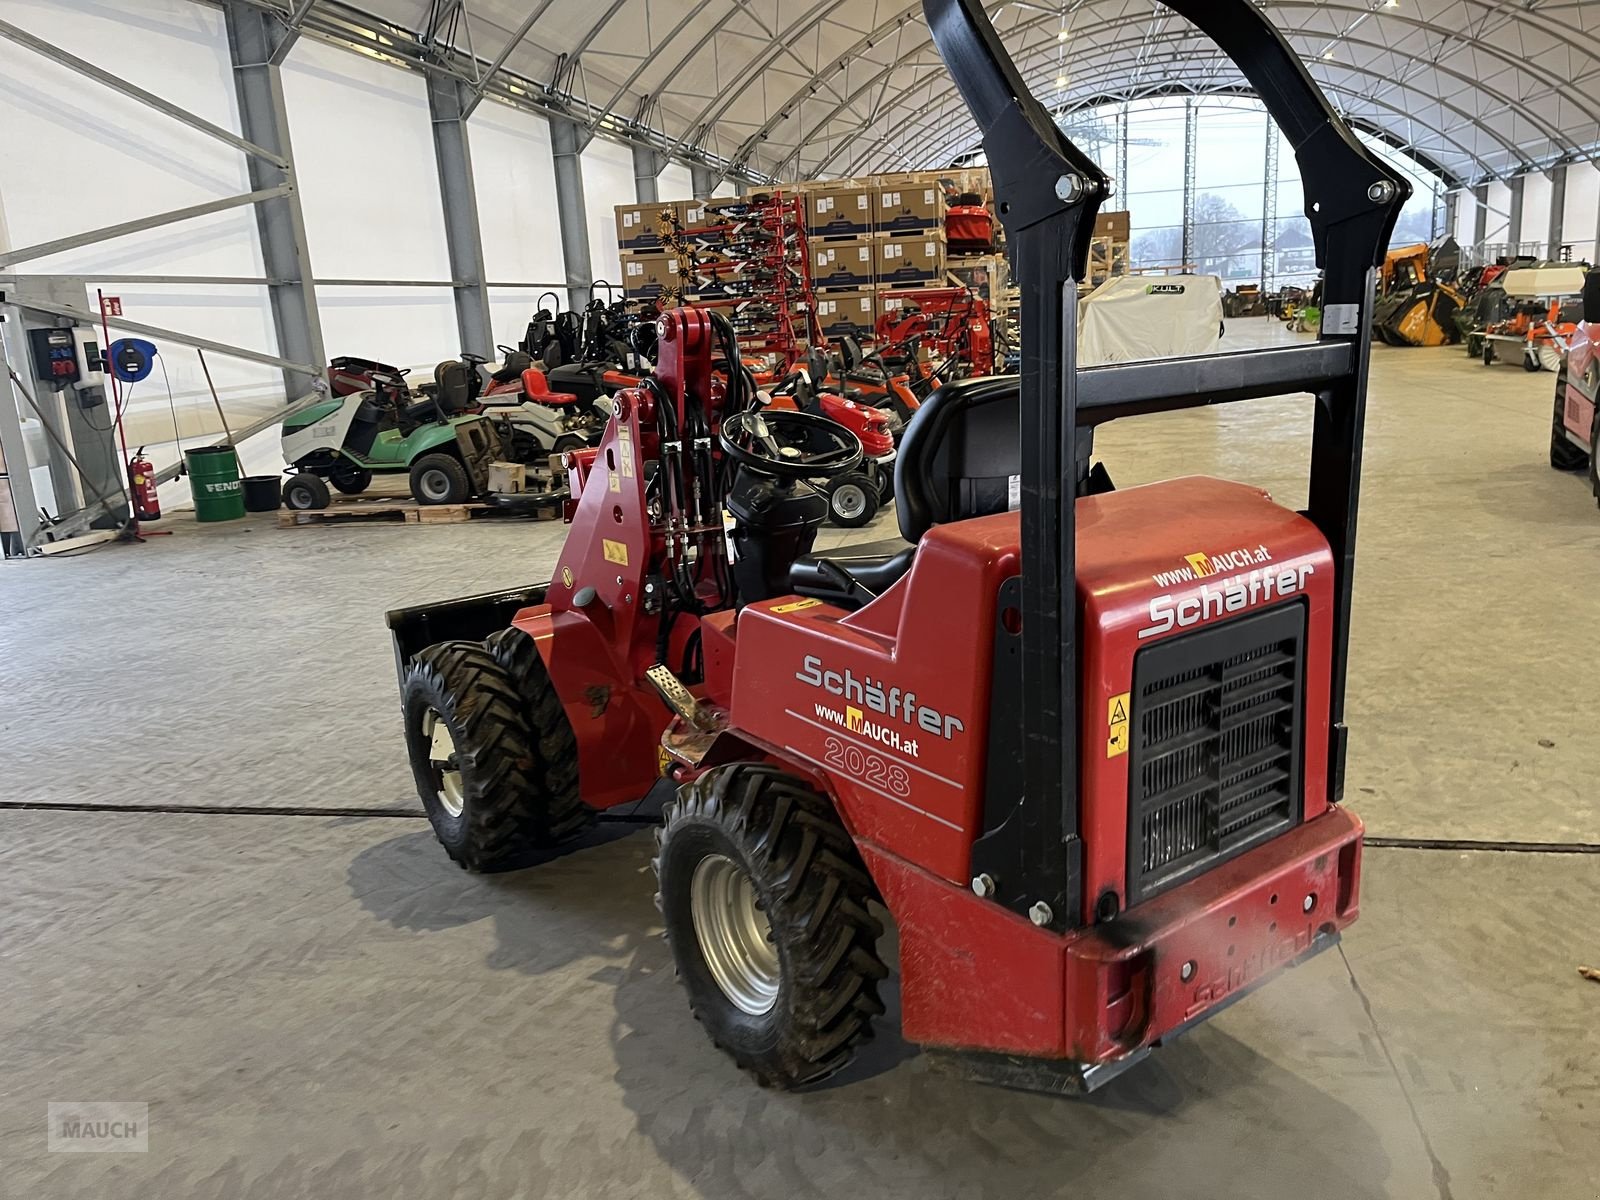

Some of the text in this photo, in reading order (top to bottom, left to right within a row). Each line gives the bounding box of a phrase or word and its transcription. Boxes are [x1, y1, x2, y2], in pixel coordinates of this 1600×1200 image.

[1152, 544, 1272, 588] www.MAUCH.at
[1138, 564, 1314, 640] Schäffer
[795, 654, 965, 741] Schäffer
[814, 703, 919, 757] www.MAUCH.at
[823, 736, 910, 797] 2028
